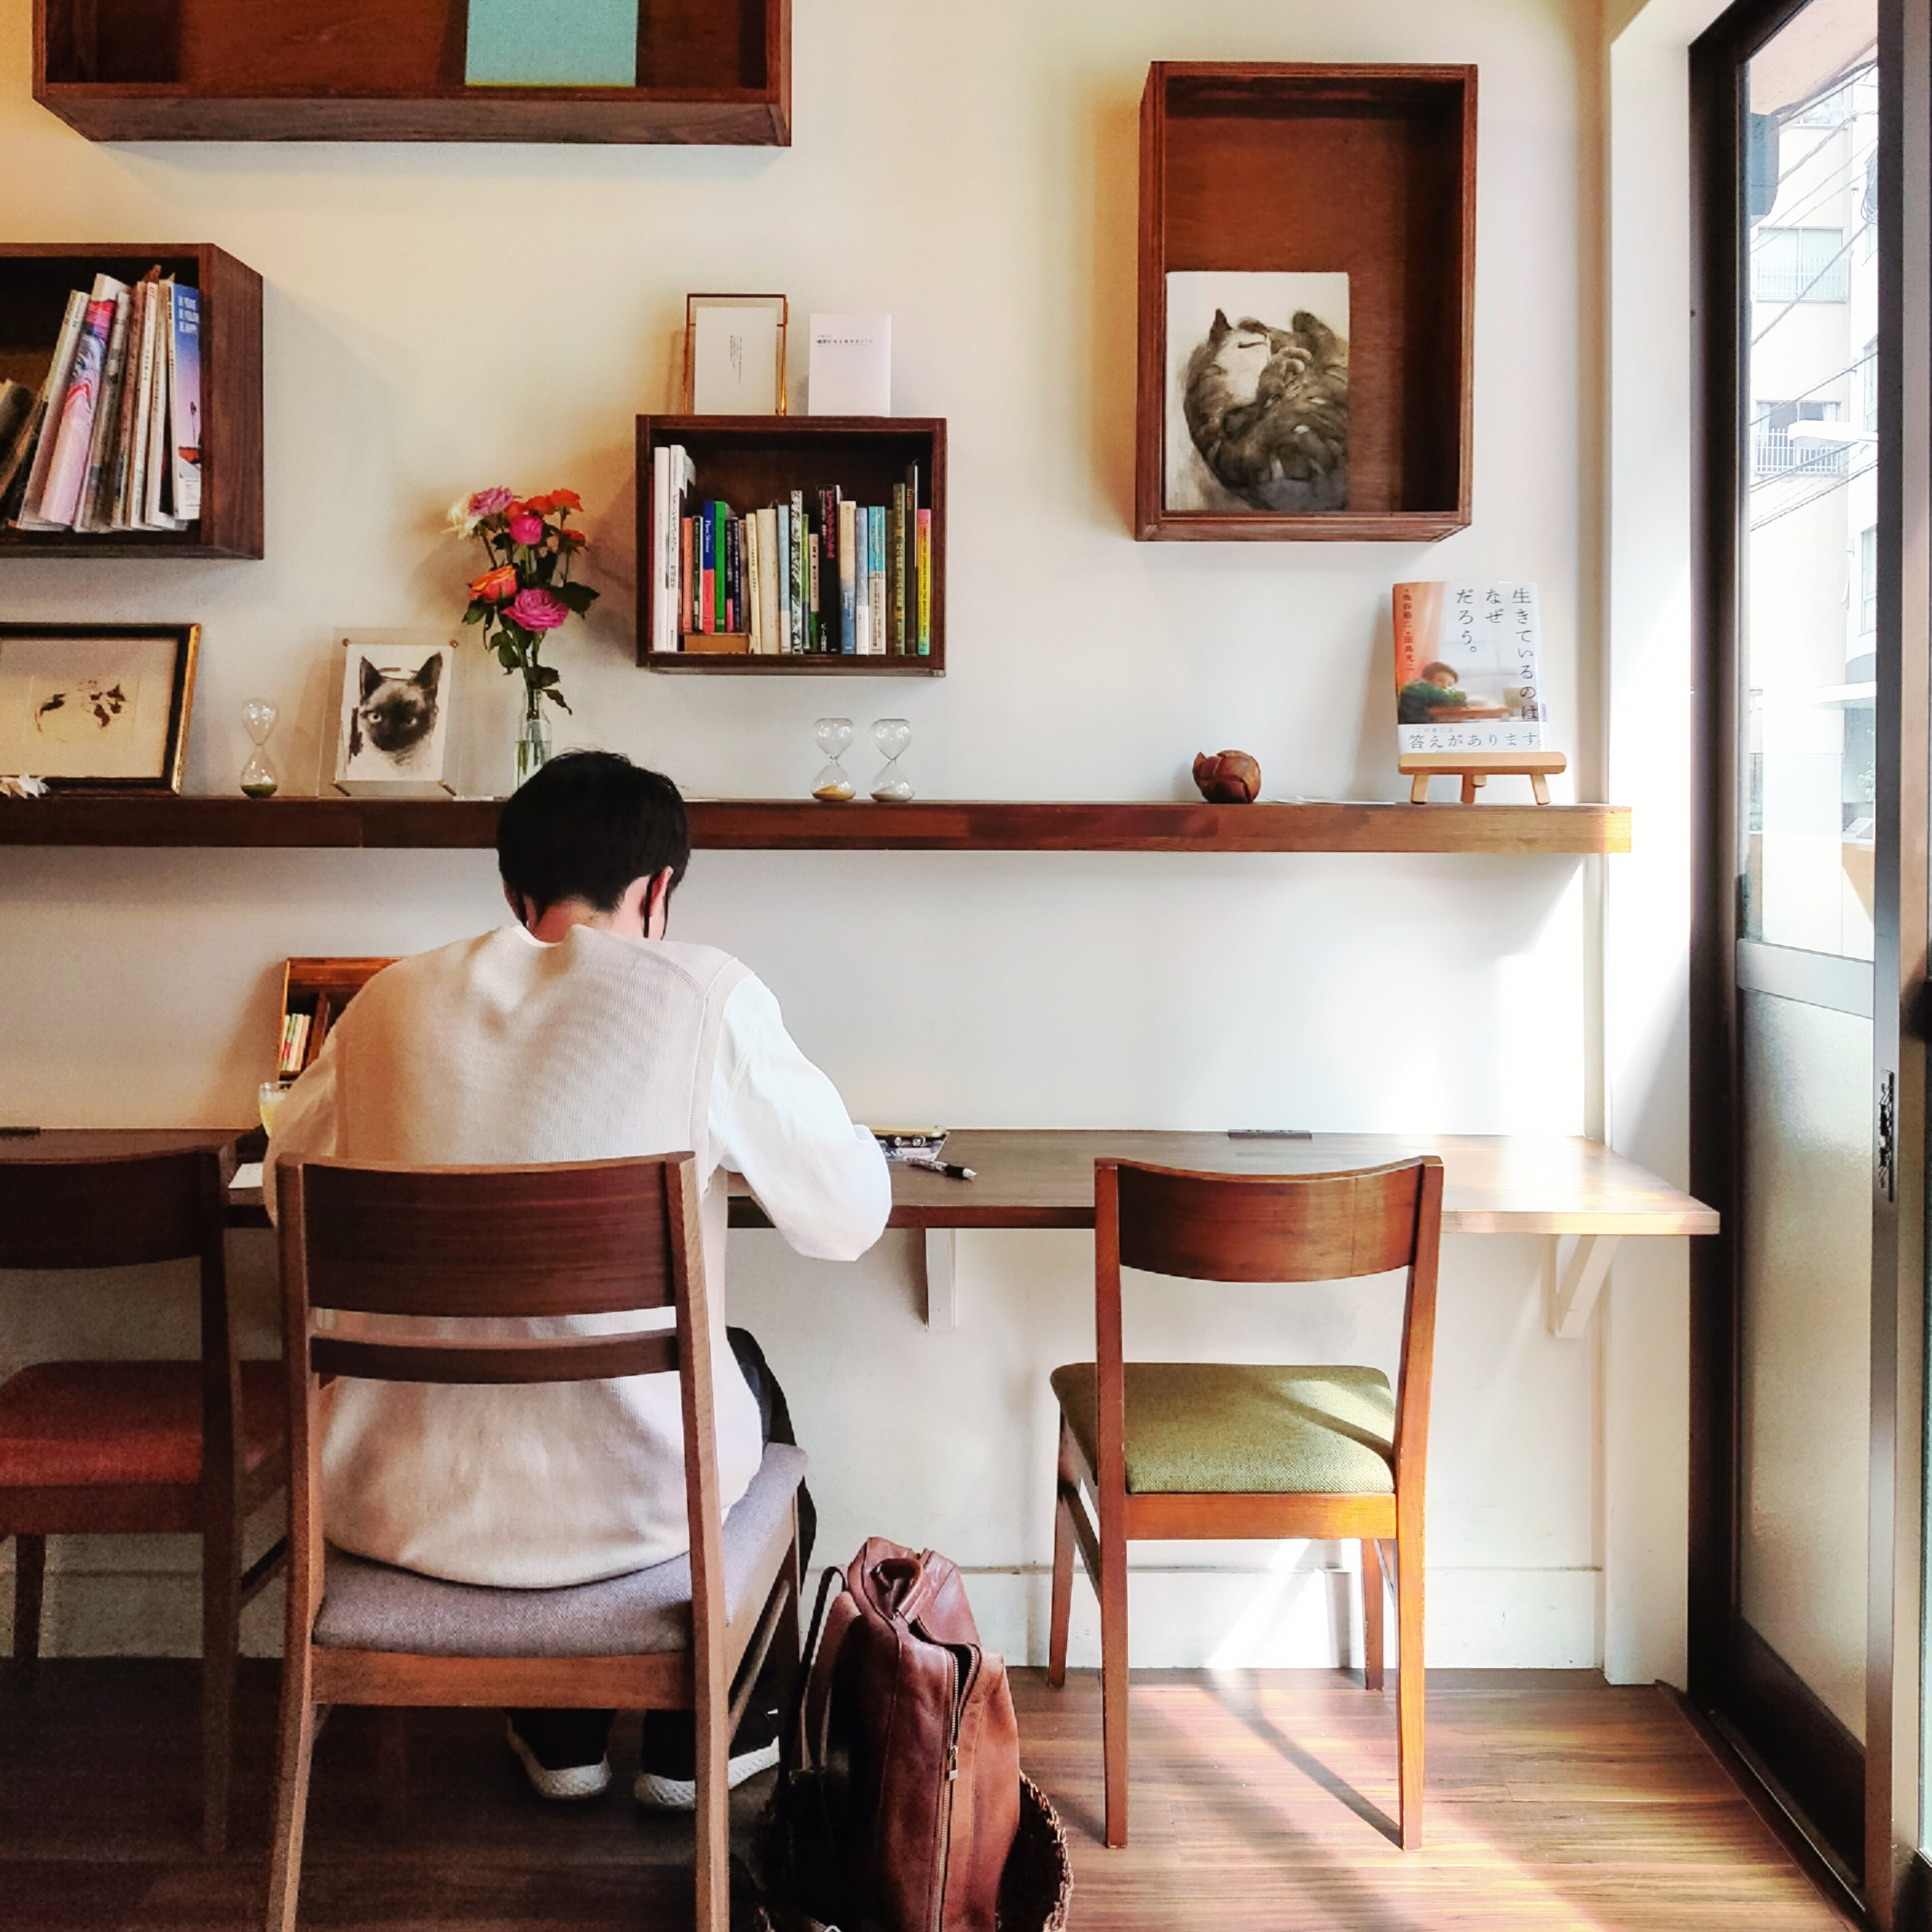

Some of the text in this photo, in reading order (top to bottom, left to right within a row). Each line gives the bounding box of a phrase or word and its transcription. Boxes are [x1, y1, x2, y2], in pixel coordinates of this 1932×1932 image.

[1456, 587, 1477, 653] だろう。
[1485, 587, 1504, 624] なぜ
[1511, 587, 1538, 721] 生きているのは
